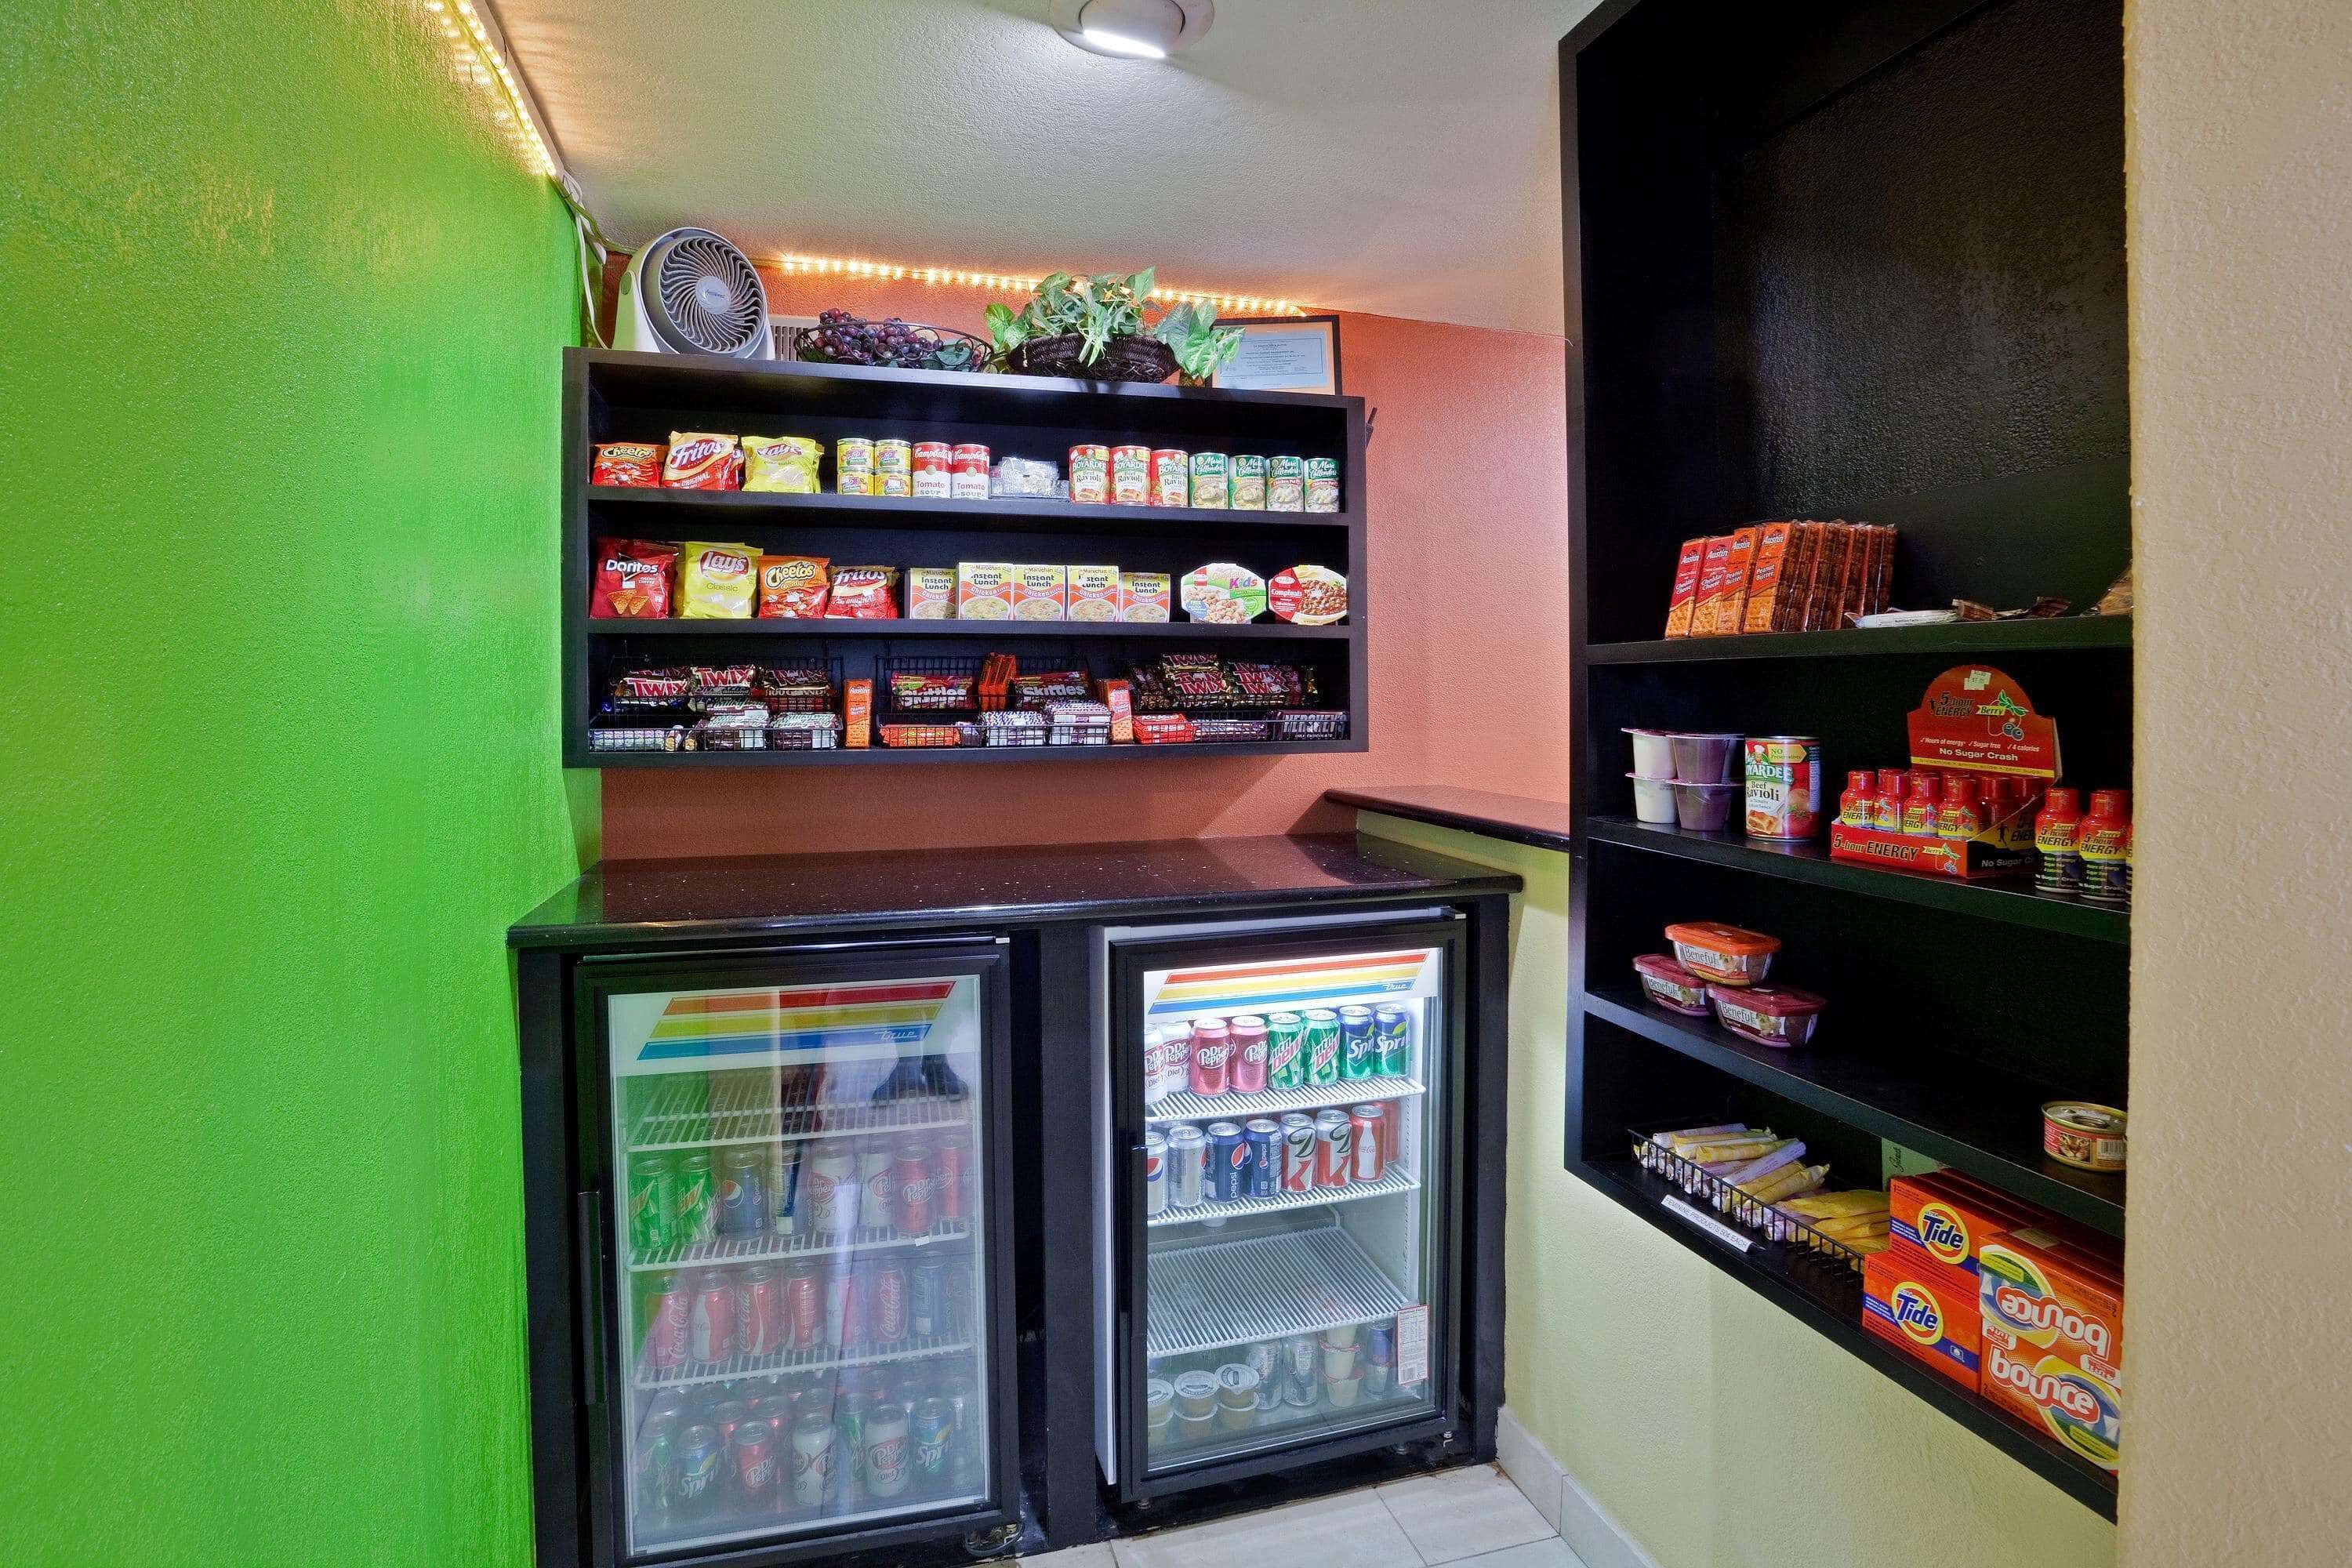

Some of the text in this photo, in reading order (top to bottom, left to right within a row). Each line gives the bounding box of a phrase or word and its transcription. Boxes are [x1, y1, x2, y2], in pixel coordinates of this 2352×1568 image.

[670, 441, 724, 470] Fritos
[1206, 456, 1222, 466] Marie
[1247, 459, 1264, 468] Marie
[1279, 459, 1297, 469] Marie
[1317, 460, 1334, 470] Marie
[681, 471, 711, 486] ORIGINAL
[1076, 474, 1102, 483] Ravioli
[1117, 474, 1142, 483] Ravioli
[956, 482, 985, 491] Tomato
[1731, 541, 1750, 550] Austin
[1763, 535, 1784, 545] Austin
[1680, 554, 1700, 564] Austin
[1706, 548, 1728, 560] Austin
[606, 558, 659, 574] Doritos
[1756, 564, 1775, 574] Peanut
[765, 562, 816, 590] Cheetos
[1726, 568, 1744, 579] Peanut
[1756, 572, 1773, 582] Butter
[1229, 575, 1258, 590] Kids
[1676, 578, 1694, 590] Cheddar
[1700, 574, 1722, 586] Cheddar
[1702, 580, 1720, 590] Cheese
[1726, 576, 1742, 586] Butter
[706, 583, 739, 593] Classic
[971, 586, 998, 597] Chicken
[1024, 588, 1050, 598] Chicken
[1677, 585, 1692, 594] Cheese
[921, 590, 948, 601] Chicken
[1079, 589, 1104, 599] Chicken
[1132, 593, 1156, 604] Chicken
[846, 597, 877, 605] ORIGINAL
[1935, 706, 1973, 717] ENERGY
[1980, 706, 2003, 715] Berry
[1283, 713, 1348, 733] HERSHEY'S
[1940, 747, 2019, 761] No Sugar Crash
[1751, 780, 1767, 789] Beef
[1842, 811, 1874, 821] ENERGY
[2040, 826, 2069, 839] 5-hour
[2037, 836, 2078, 848] ENERGY
[2083, 833, 2114, 845] 5-hour
[1833, 833, 1919, 861] 5-hour ENERGY
[1926, 847, 1943, 855] Berry
[2081, 843, 2122, 855] ENERGY
[1980, 858, 2022, 868] No Sugar
[1685, 946, 1716, 967] Beneful
[1649, 978, 1678, 996] Beneful
[1723, 1006, 1756, 1022] Beneful
[1176, 1043, 1185, 1052] Dr
[1210, 1045, 1222, 1055] Dr
[1200, 1048, 1229, 1065] Pepper
[1167, 1068, 1181, 1076] Diet
[1229, 1171, 1238, 1200] pepsi
[1664, 1197, 1691, 1217] FEMININE
[1689, 1211, 1721, 1232] PRODUCTS
[1729, 1236, 1749, 1248] EACH
[1922, 1214, 1965, 1250] Tide
[1896, 1292, 1939, 1330] Tide
[2001, 1294, 2109, 1357] bounce
[1990, 1347, 2095, 1415] bounce
